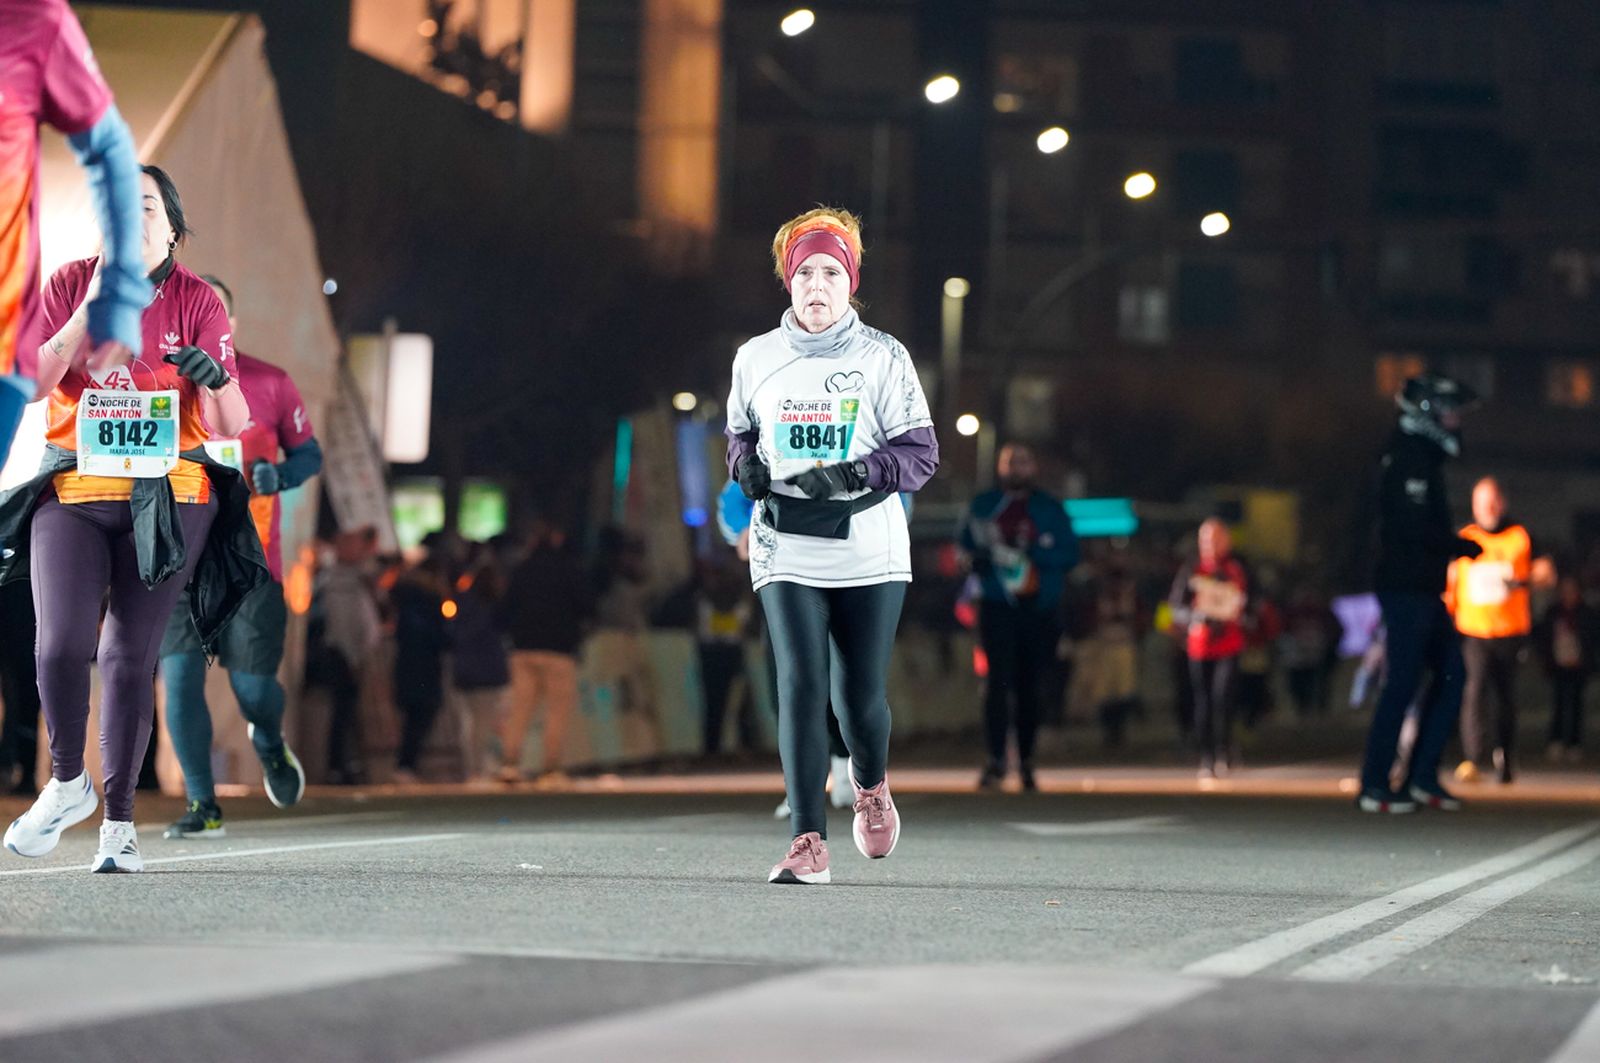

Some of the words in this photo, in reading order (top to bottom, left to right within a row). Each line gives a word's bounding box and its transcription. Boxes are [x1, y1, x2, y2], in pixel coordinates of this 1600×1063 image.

[99, 399, 129, 408] NOCHE
[130, 399, 142, 408] DE
[821, 403, 832, 411] DE
[88, 409, 108, 419] SAN
[109, 406, 142, 419] ANTÓN
[781, 413, 799, 422] SAN
[98, 420, 158, 447] 8142
[789, 424, 847, 450] 8841
[109, 448, 130, 456] MARÍA
